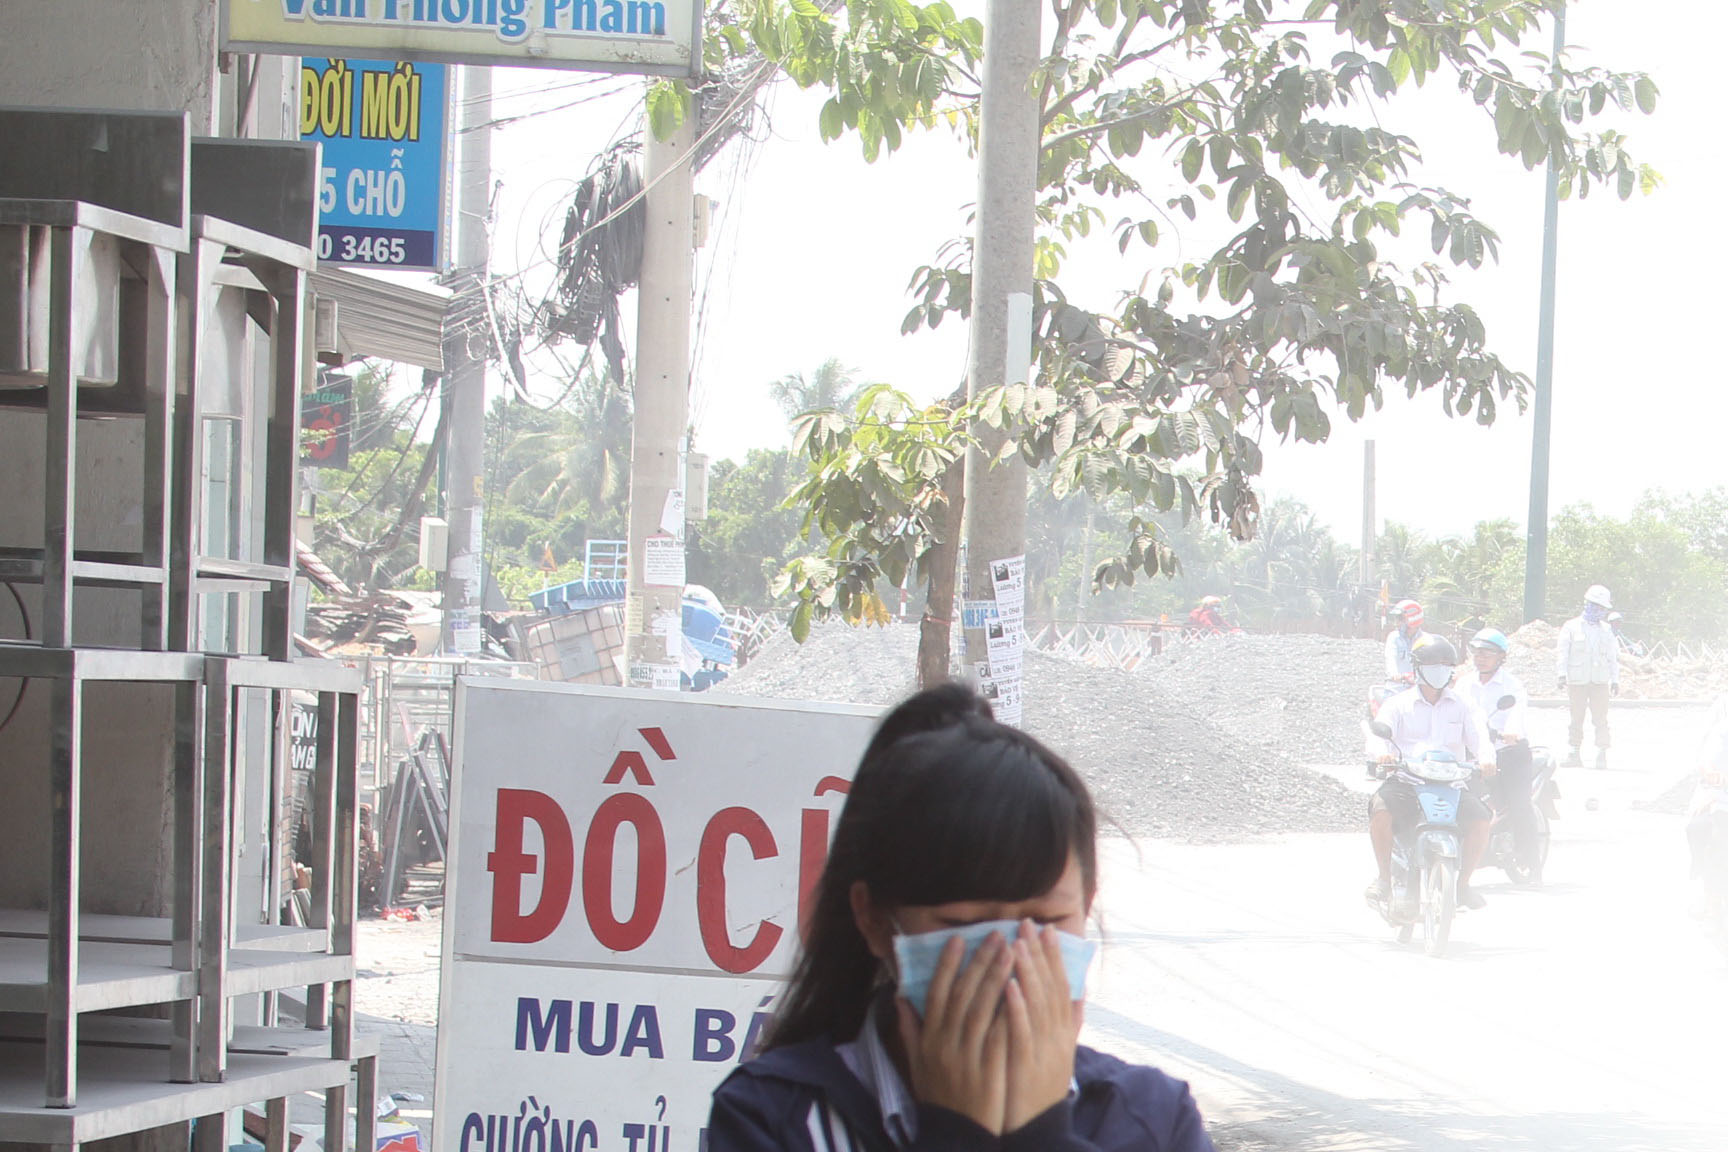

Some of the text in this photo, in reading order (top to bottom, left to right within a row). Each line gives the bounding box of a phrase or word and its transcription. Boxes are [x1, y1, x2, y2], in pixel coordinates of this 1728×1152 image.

[347, 149, 405, 217] CHỖ
[341, 235, 405, 263] 3465
[487, 727, 677, 951] ĐỒ
[514, 997, 664, 1059] MUA
